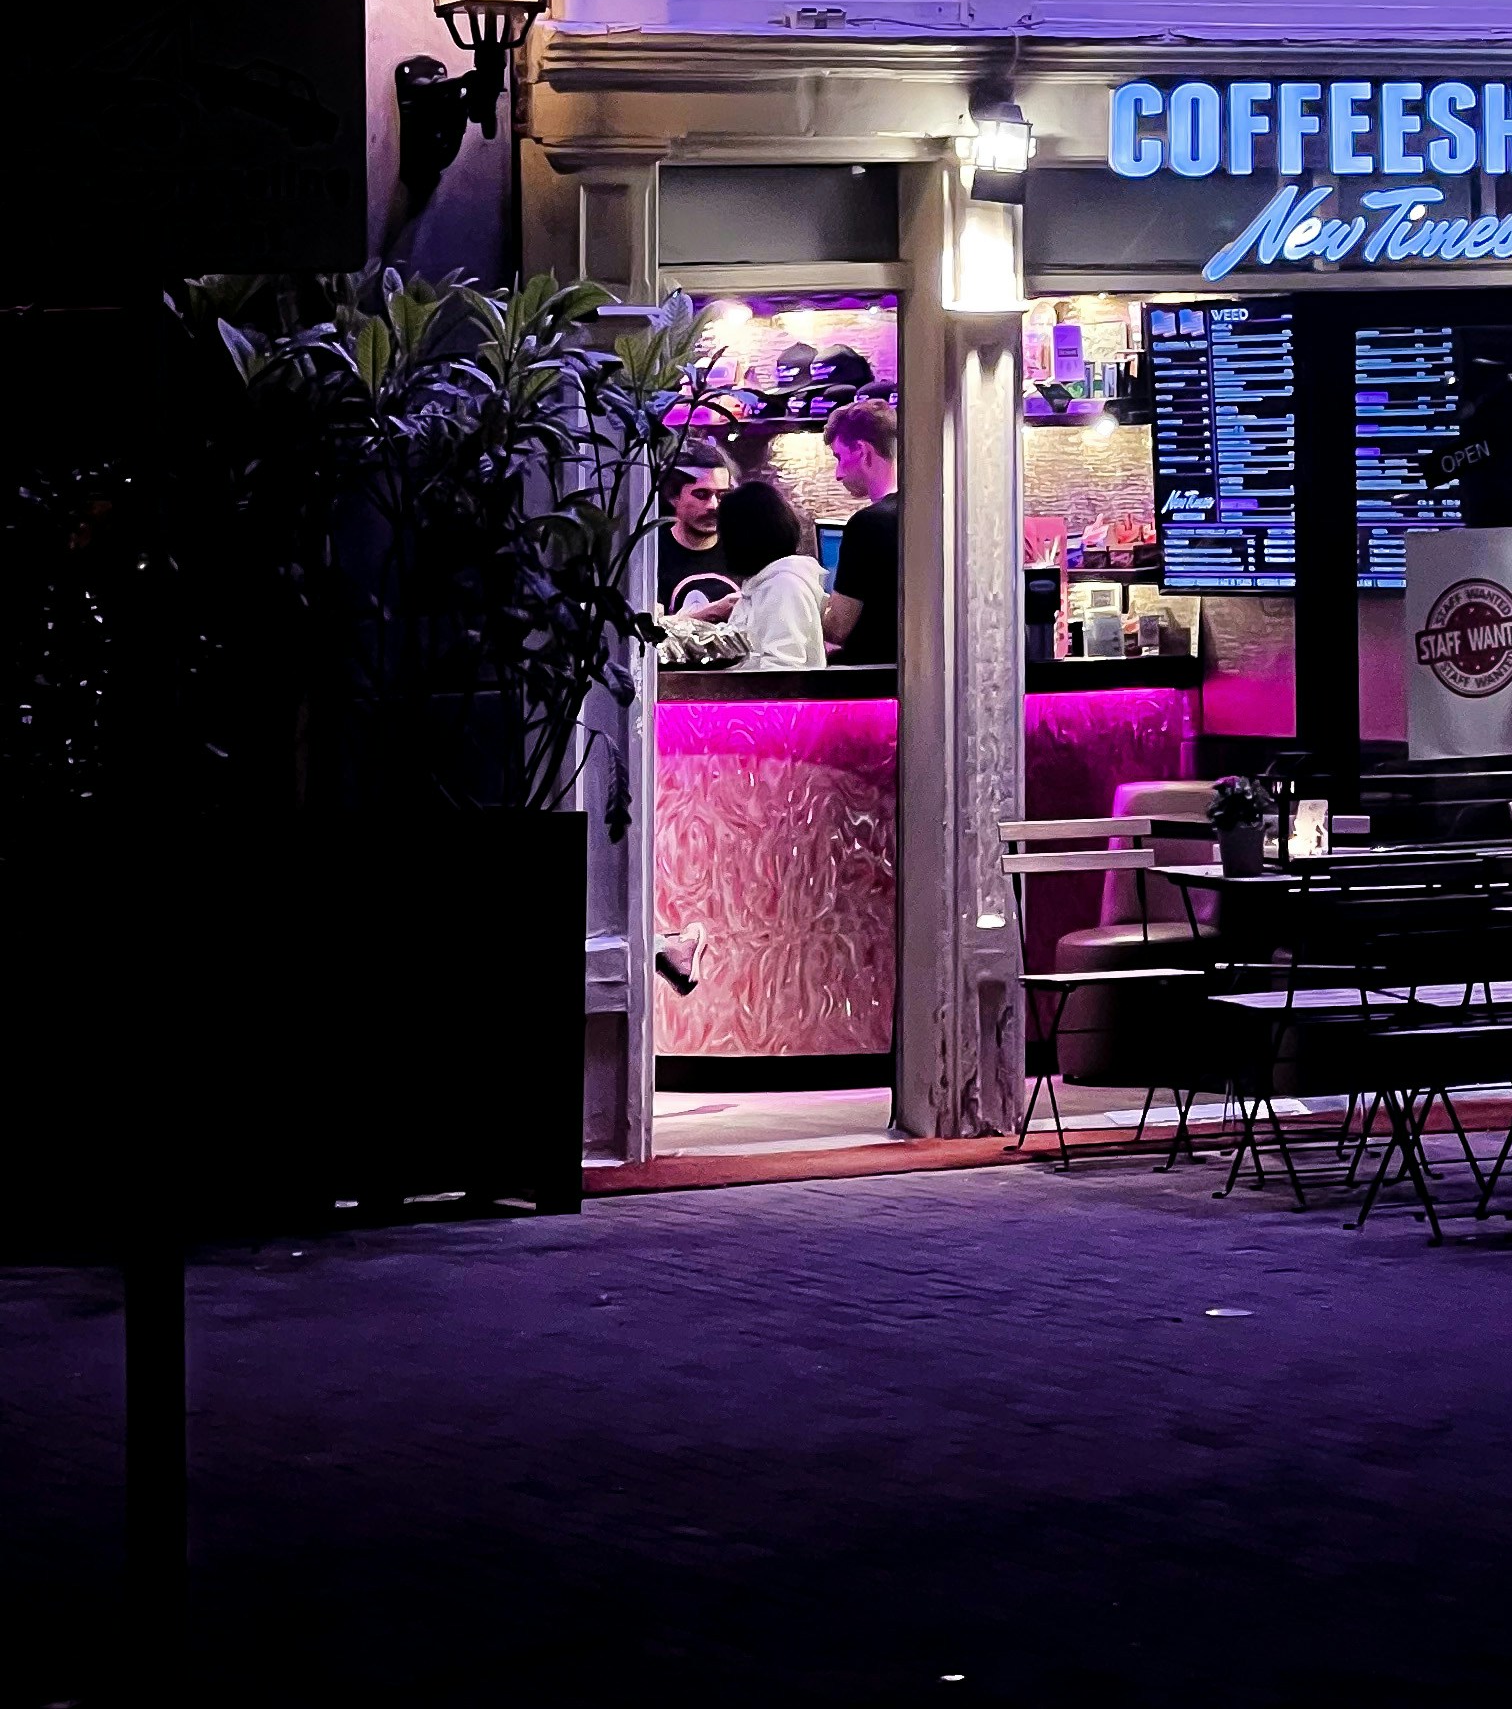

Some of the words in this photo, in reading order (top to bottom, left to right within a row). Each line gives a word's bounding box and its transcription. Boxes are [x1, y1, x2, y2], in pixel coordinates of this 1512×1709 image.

[1202, 185, 1366, 282] New
[1211, 308, 1249, 321] WEED
[1441, 439, 1490, 472] OPEN
[1420, 631, 1461, 661] STAFF
